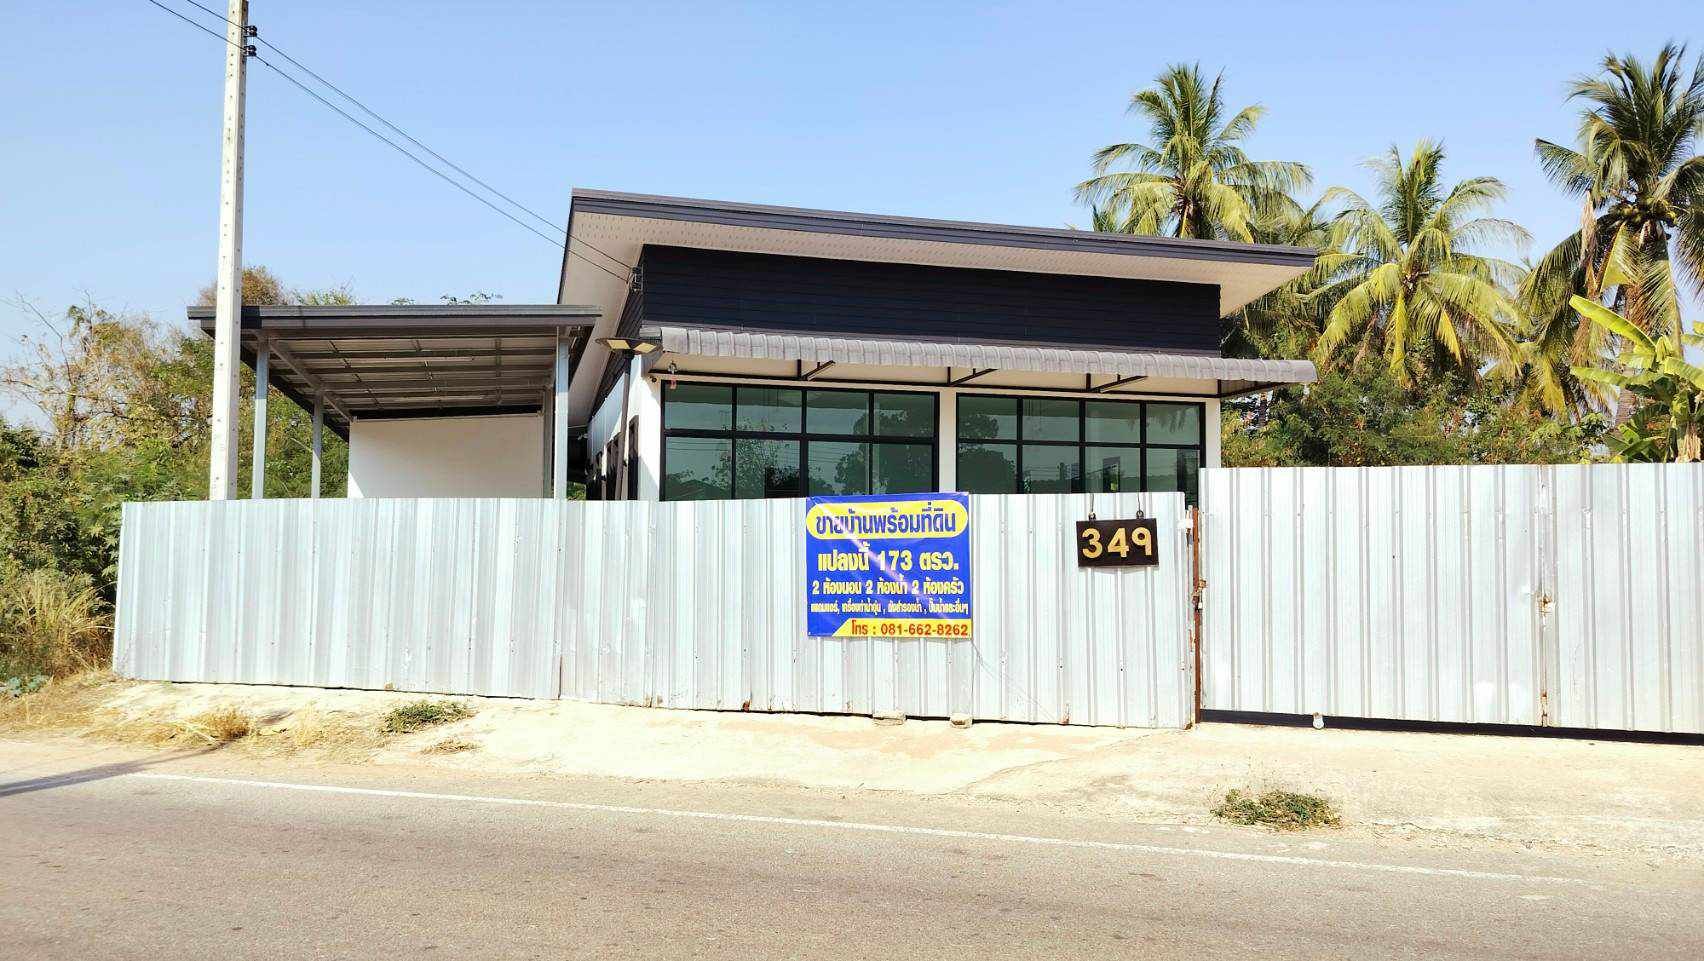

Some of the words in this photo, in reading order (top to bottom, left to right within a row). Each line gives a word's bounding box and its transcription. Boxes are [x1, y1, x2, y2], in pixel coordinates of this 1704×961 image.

[816, 502, 956, 534] ขายบ้านพร้อมที่ดิน
[818, 541, 870, 572] แปลงนี้
[878, 550, 913, 571] 173
[919, 551, 959, 571] ตรว.
[1082, 527, 1152, 558] 349
[812, 580, 820, 595] 2
[823, 577, 862, 595] ห้องนอน
[865, 580, 874, 595] 2
[876, 573, 908, 595] ห้องน้ำ
[911, 580, 920, 595] 2
[923, 576, 965, 595] ห้องครัว
[851, 619, 868, 636] โทร
[880, 623, 969, 637] 081-662-8262
